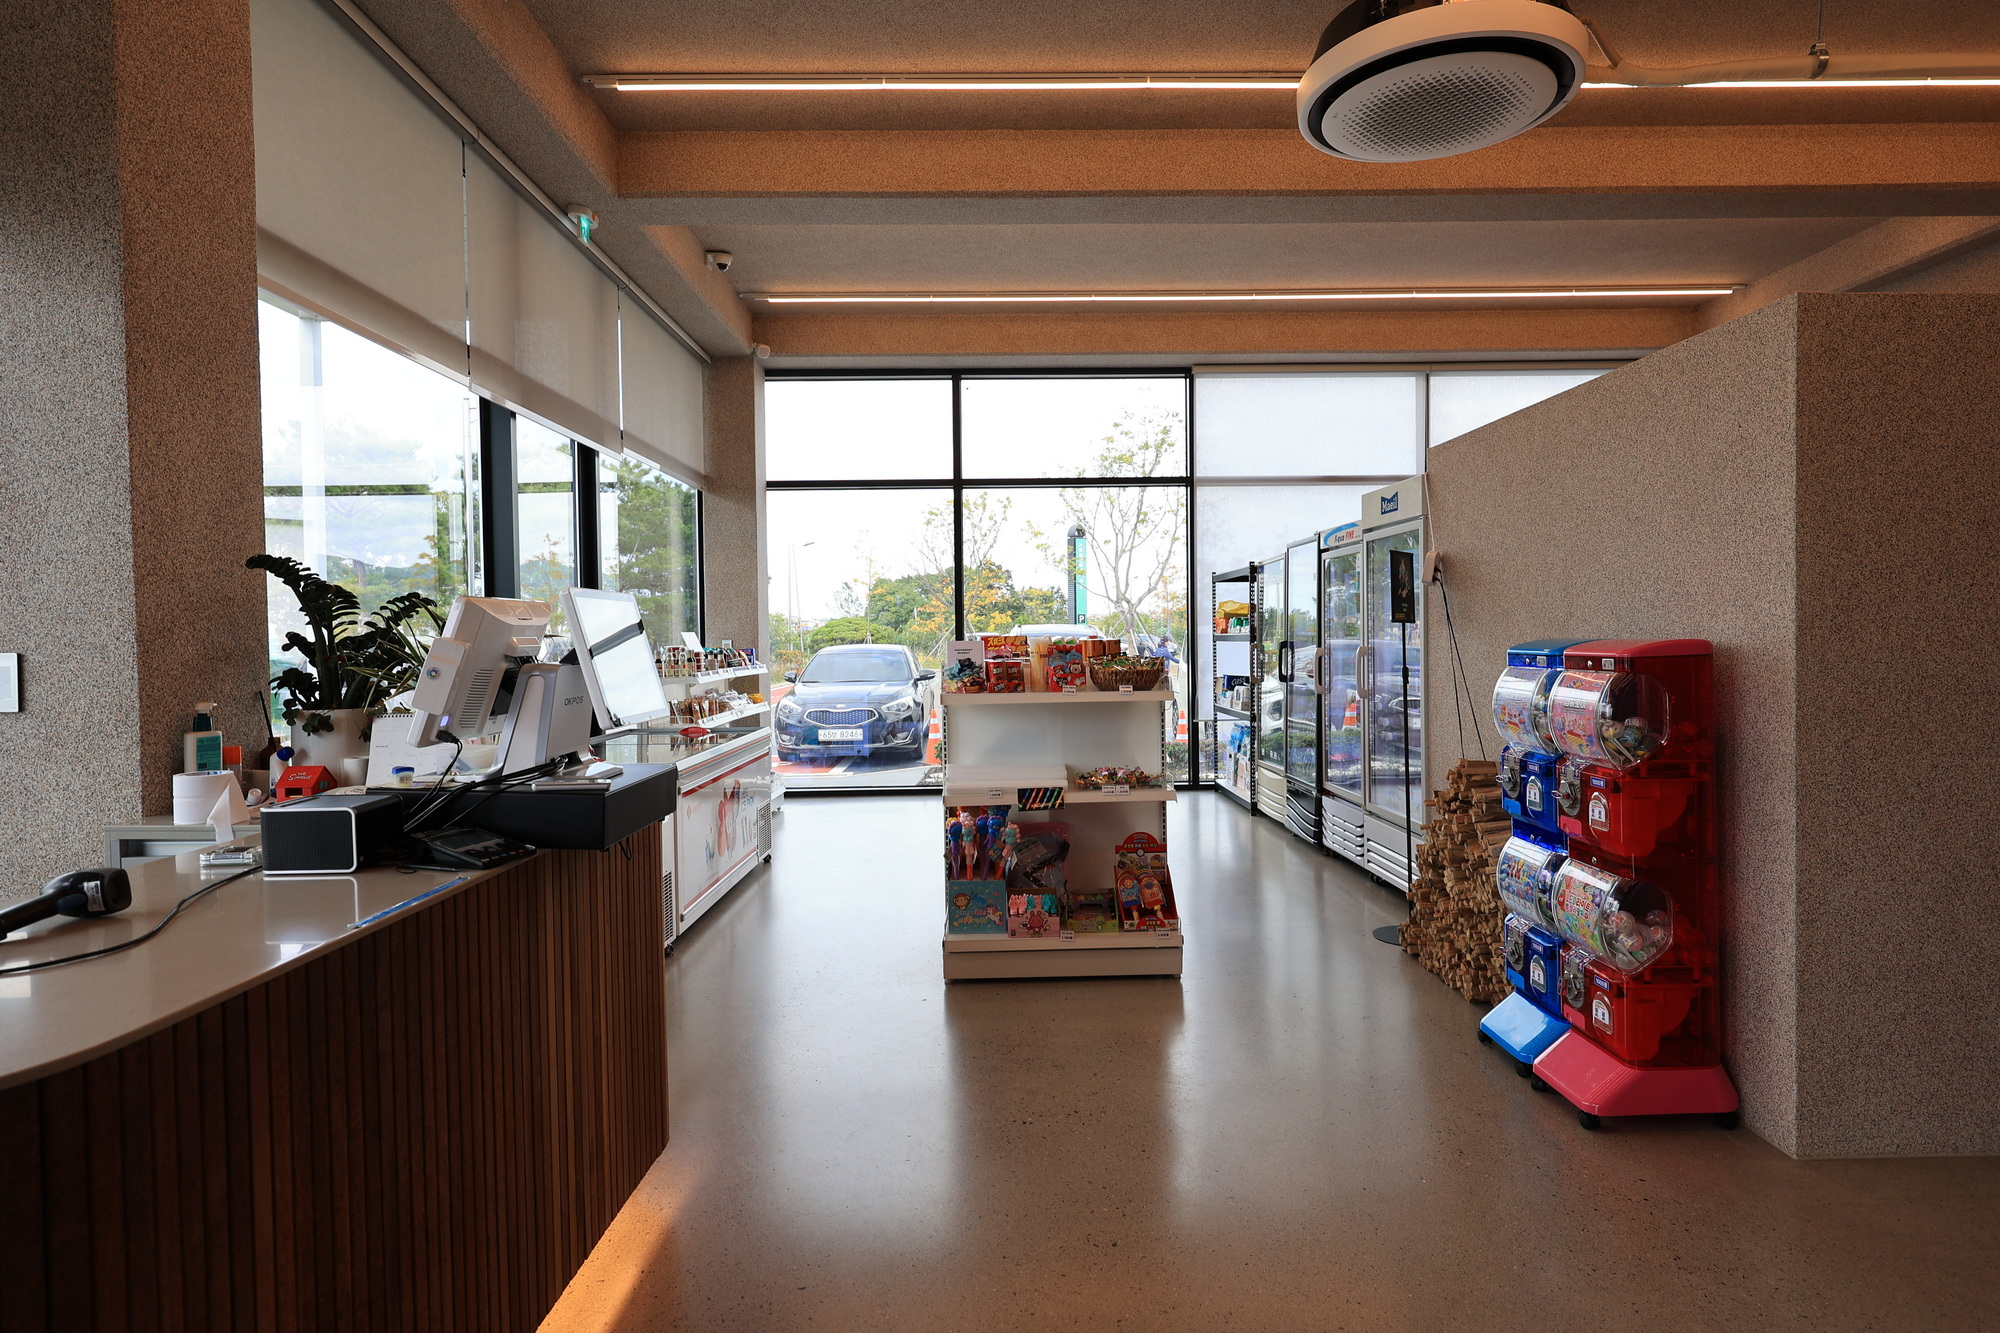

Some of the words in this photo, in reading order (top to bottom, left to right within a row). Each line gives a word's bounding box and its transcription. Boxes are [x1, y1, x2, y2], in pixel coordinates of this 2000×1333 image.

[1381, 496, 1398, 513] Maeil
[1345, 530, 1355, 539] FINE
[564, 695, 584, 706] OKPOS
[839, 730, 859, 739] 8246
